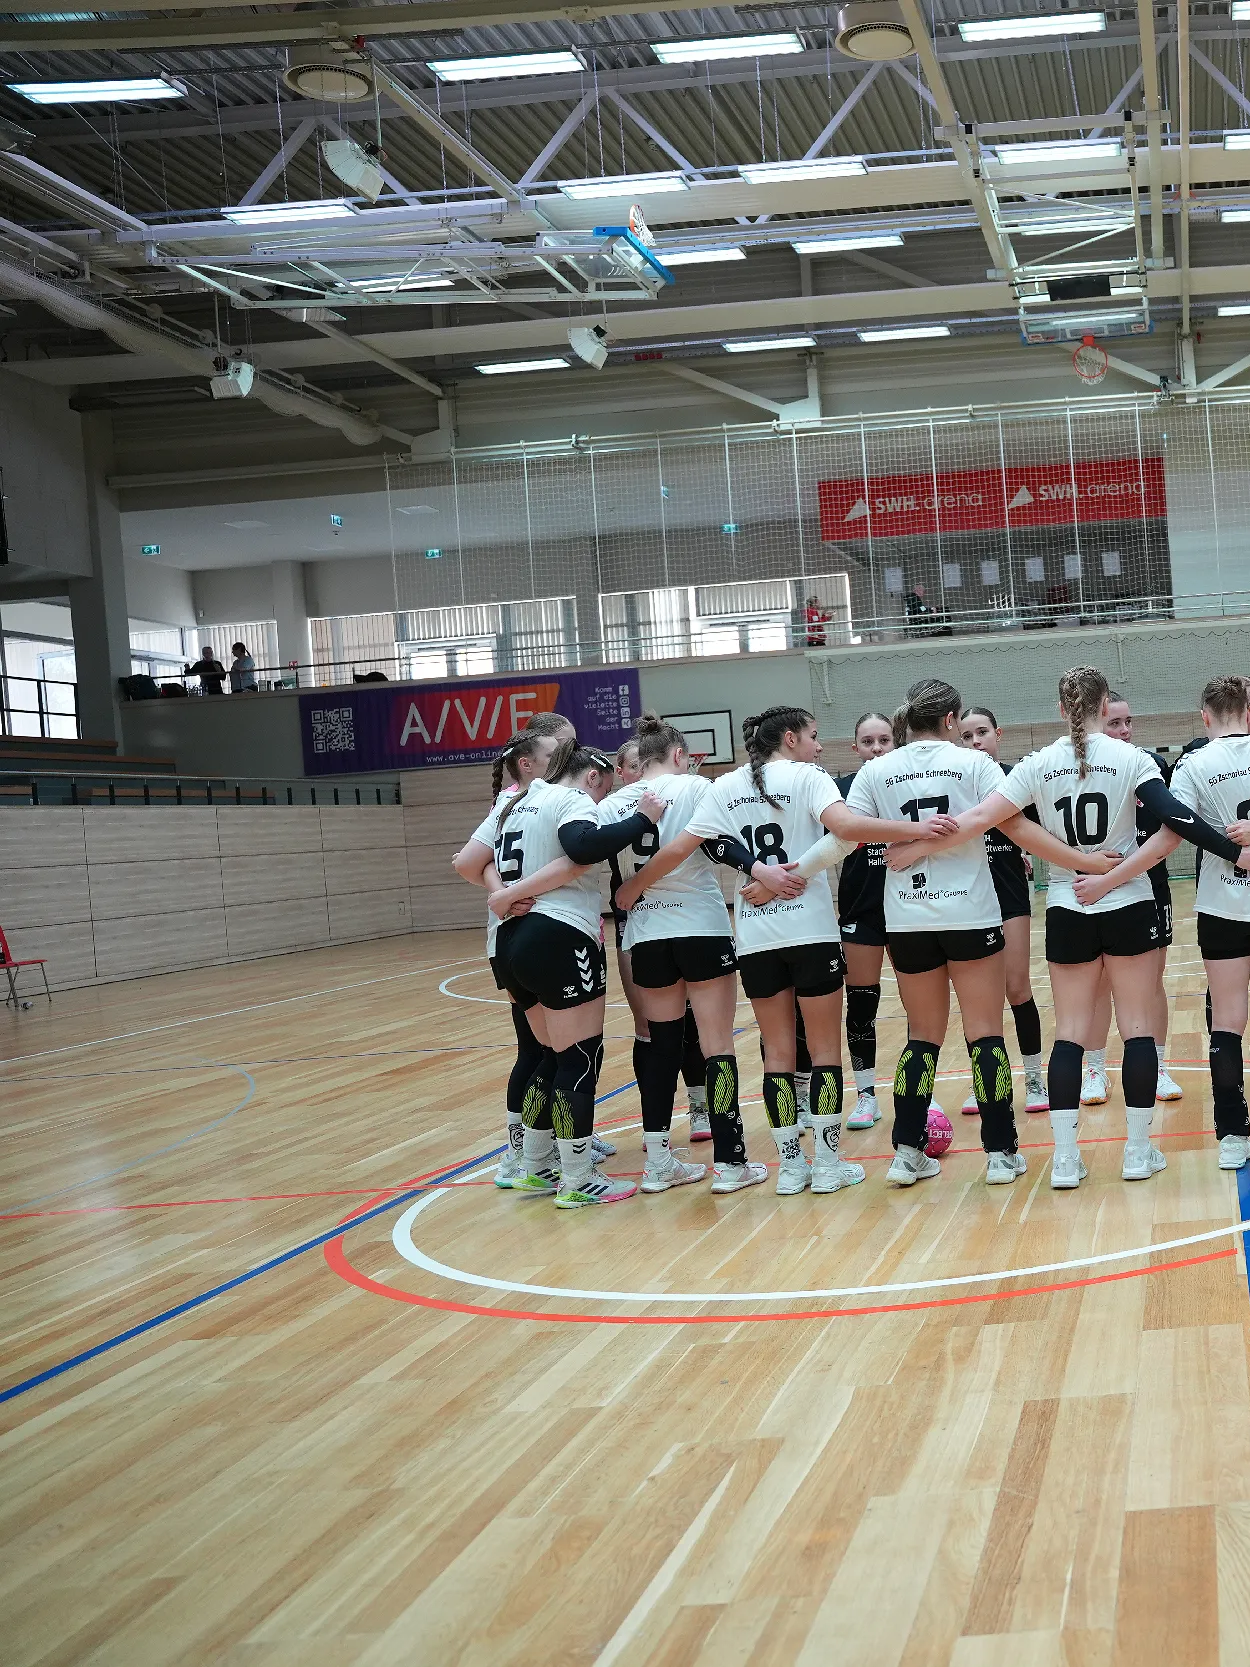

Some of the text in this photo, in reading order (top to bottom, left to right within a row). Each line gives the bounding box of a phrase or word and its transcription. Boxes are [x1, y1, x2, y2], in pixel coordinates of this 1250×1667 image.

[1087, 482, 1144, 497] arena
[924, 494, 982, 510] arena
[885, 776, 893, 788] SG
[1208, 775, 1217, 787] SG
[1054, 792, 1108, 846] 10
[740, 823, 788, 865] 18
